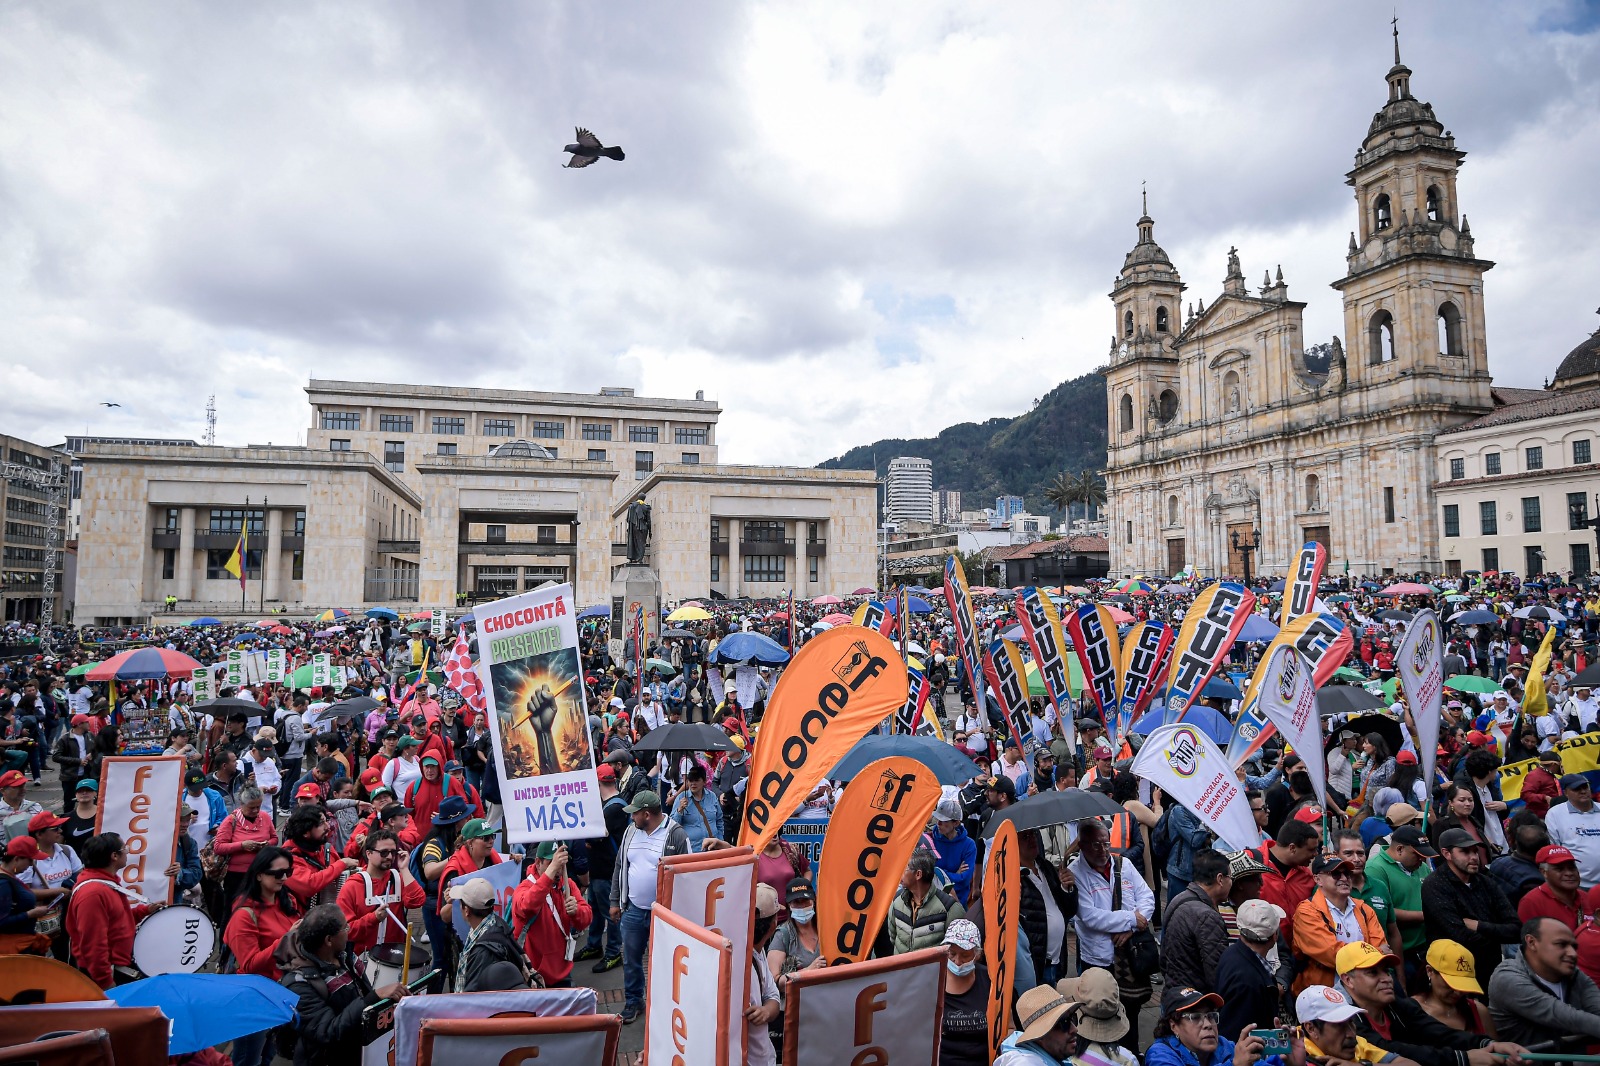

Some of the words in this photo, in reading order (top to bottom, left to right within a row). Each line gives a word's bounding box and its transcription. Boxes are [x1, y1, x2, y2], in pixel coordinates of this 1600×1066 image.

[490, 626, 561, 661] PRESENTE!
[1025, 591, 1068, 695] CUT
[1082, 610, 1117, 706] CUT
[1124, 625, 1163, 700] CUT
[1174, 588, 1243, 694] CUT
[993, 645, 1032, 739] CUT
[748, 656, 888, 835] fecode
[513, 785, 551, 800] UNIDOS
[554, 781, 588, 797] SOMOS
[525, 797, 586, 832] MÁS!
[1194, 772, 1225, 811] DEMOCRACIA
[1203, 780, 1230, 815] GARANTIAS
[1210, 787, 1238, 822] SINDICALES
[181, 918, 200, 966] BOSS
